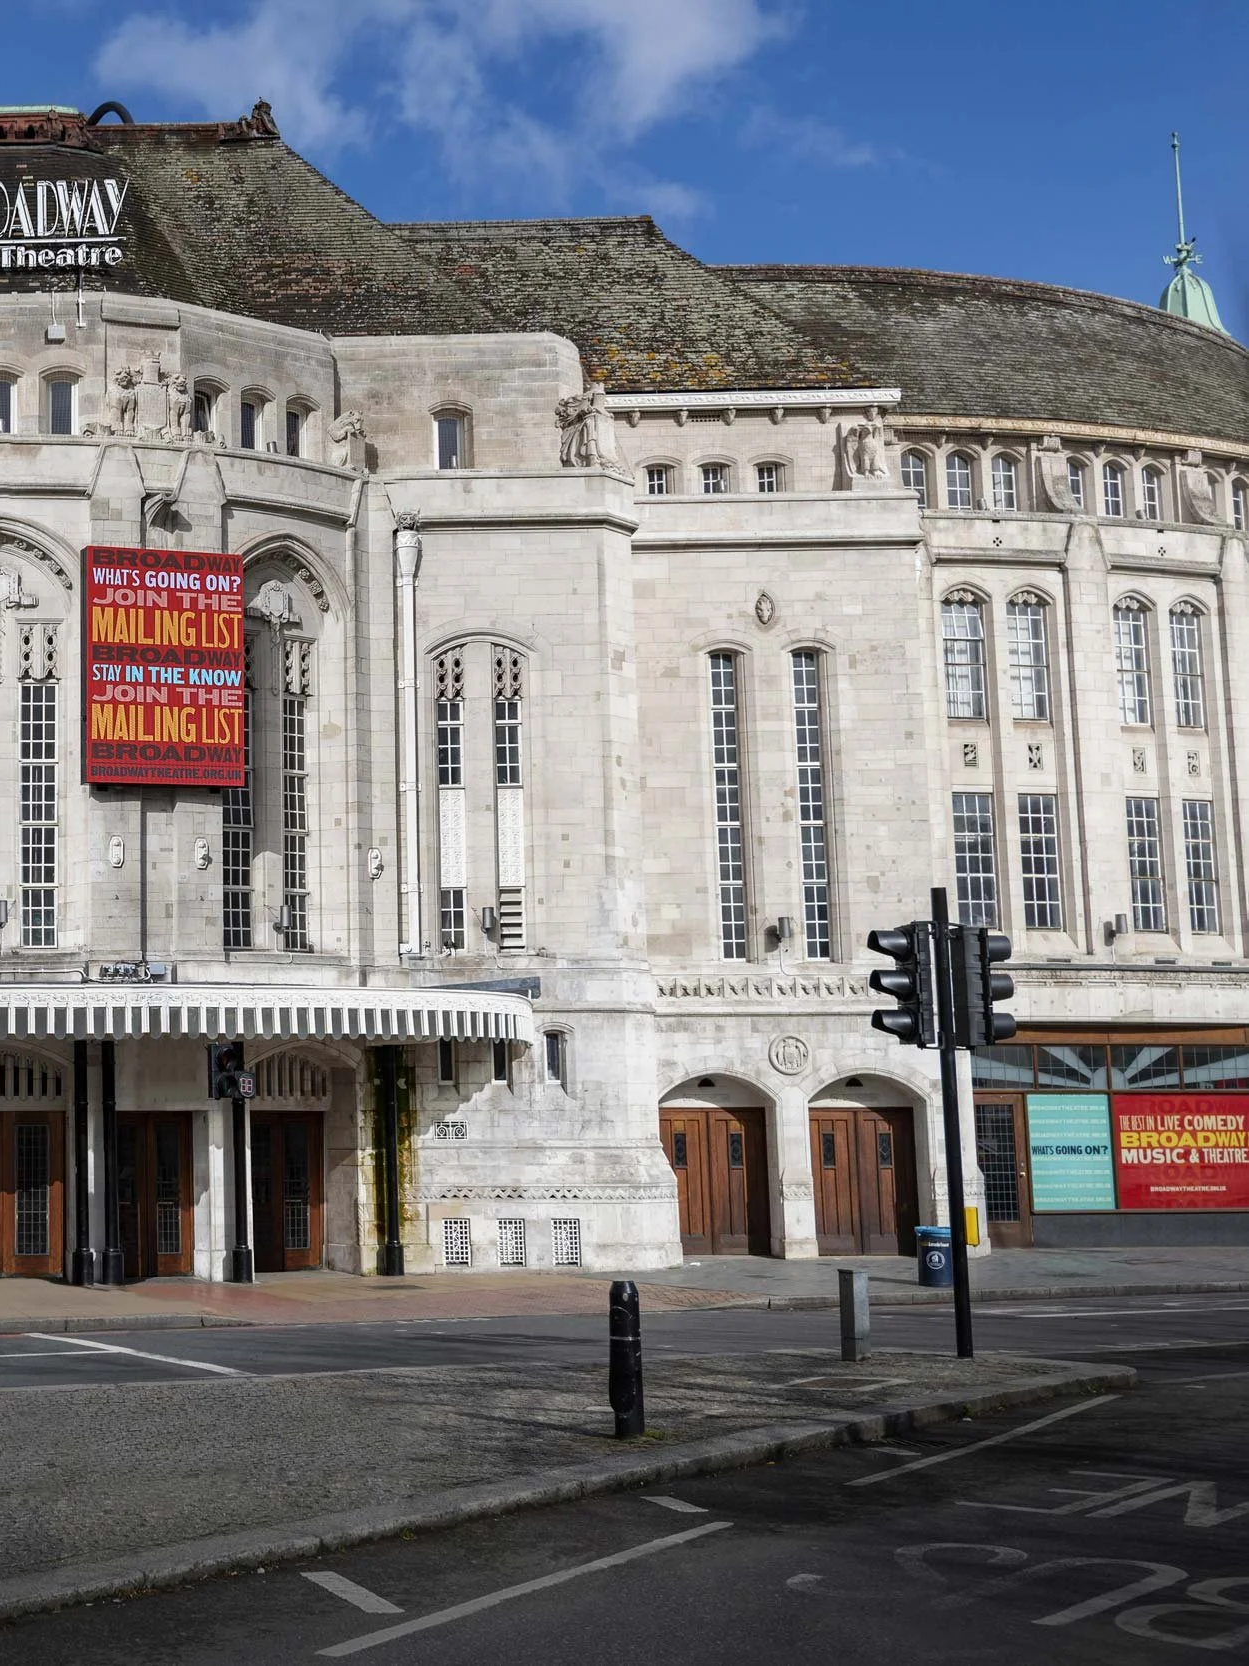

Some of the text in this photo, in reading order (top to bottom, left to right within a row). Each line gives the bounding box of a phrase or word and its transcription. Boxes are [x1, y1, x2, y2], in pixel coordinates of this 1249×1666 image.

[92, 549, 241, 573] BROADWAY
[92, 567, 241, 592] WHAT'S GOING ON?
[92, 587, 242, 612] JOIN THE
[92, 606, 242, 649] MAILING LIST
[92, 645, 241, 667] BROADWAY
[92, 664, 242, 687] STAY IN THE KNOW
[92, 684, 242, 707] JOIN THE
[91, 703, 242, 745] MAILING LIST
[91, 742, 242, 764] BROADWAY
[90, 765, 242, 781] BROADWAYTHEATRE.ORG.UK
[1118, 1114, 1245, 1131] THE BEST IN LIVE COMEDY
[1031, 1145, 1109, 1155] WHAT'S GOING ON?
[1119, 1131, 1246, 1148] BROADWAY
[1120, 1148, 1249, 1164] MUSIC & THEATRE
